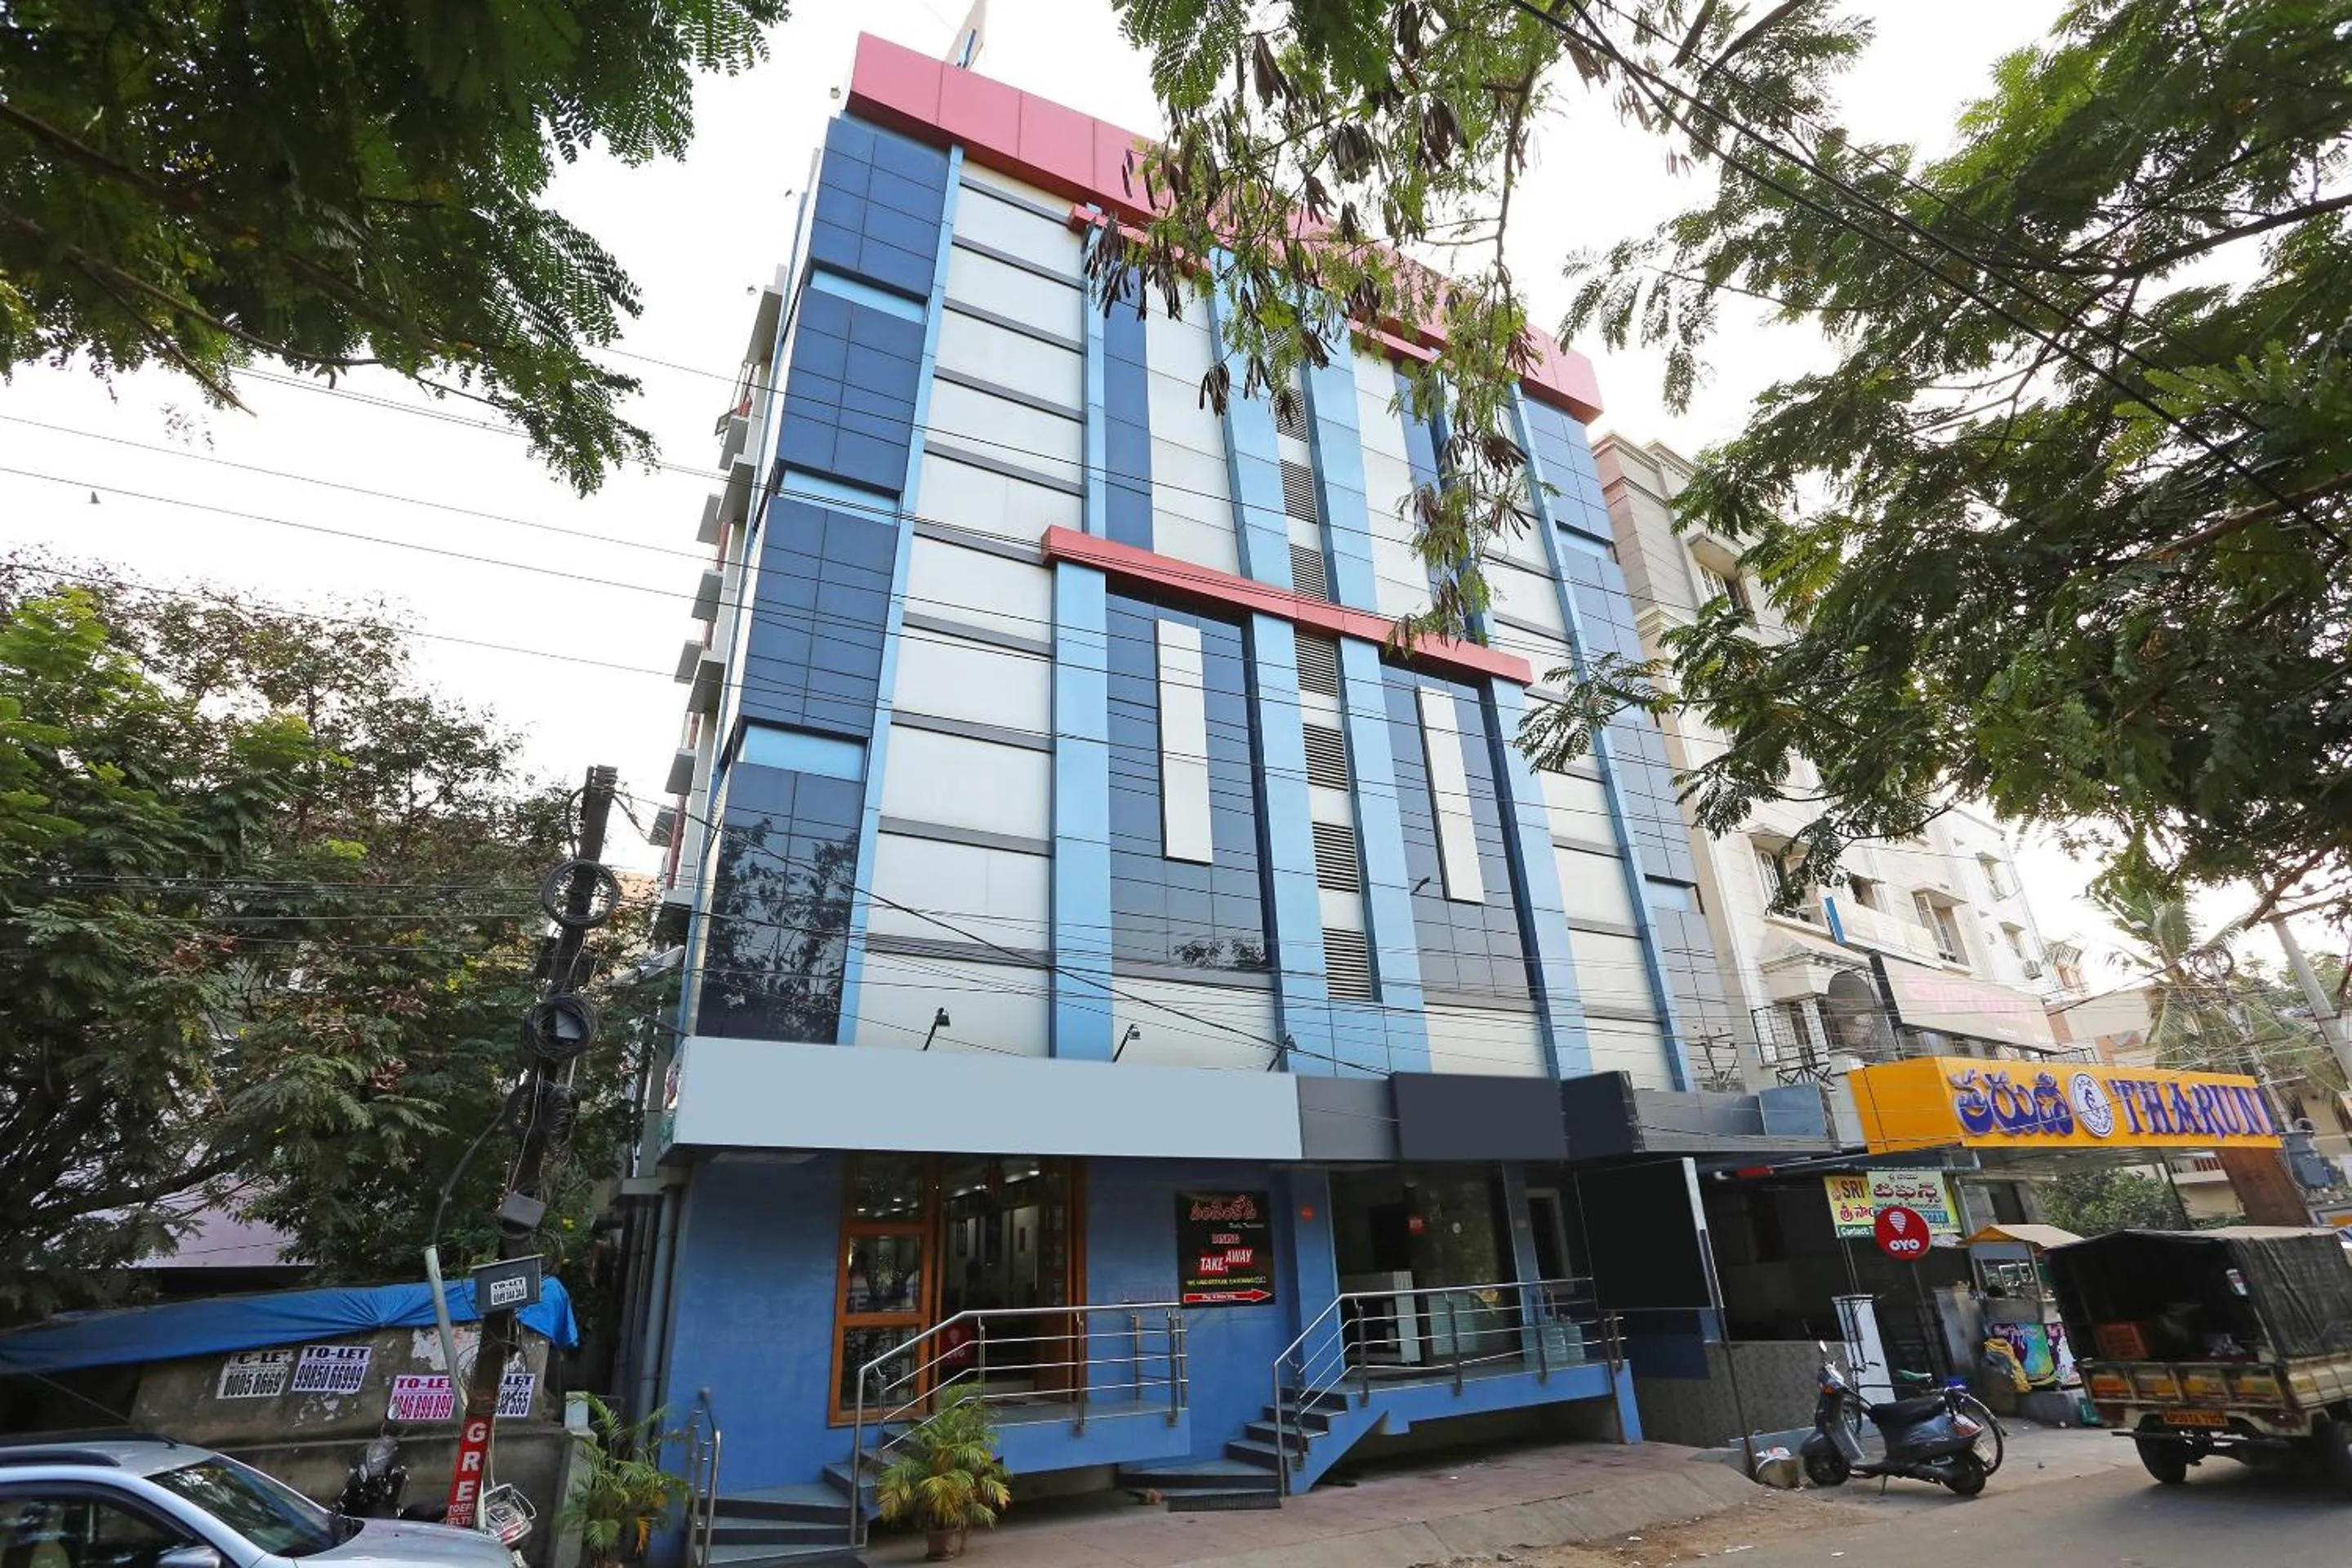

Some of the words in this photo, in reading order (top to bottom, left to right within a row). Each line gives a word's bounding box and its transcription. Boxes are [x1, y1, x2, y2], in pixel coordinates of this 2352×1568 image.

[2105, 1078, 2278, 1139] THARUNI
[1840, 1180, 1865, 1199] SRI
[1889, 1239, 1920, 1252] OYO
[1200, 1257, 1223, 1272] TAKE
[1224, 1249, 1253, 1263] AWAY
[306, 1347, 368, 1359] TO-LET
[505, 1375, 533, 1385] LET
[457, 1423, 487, 1501] GRE
